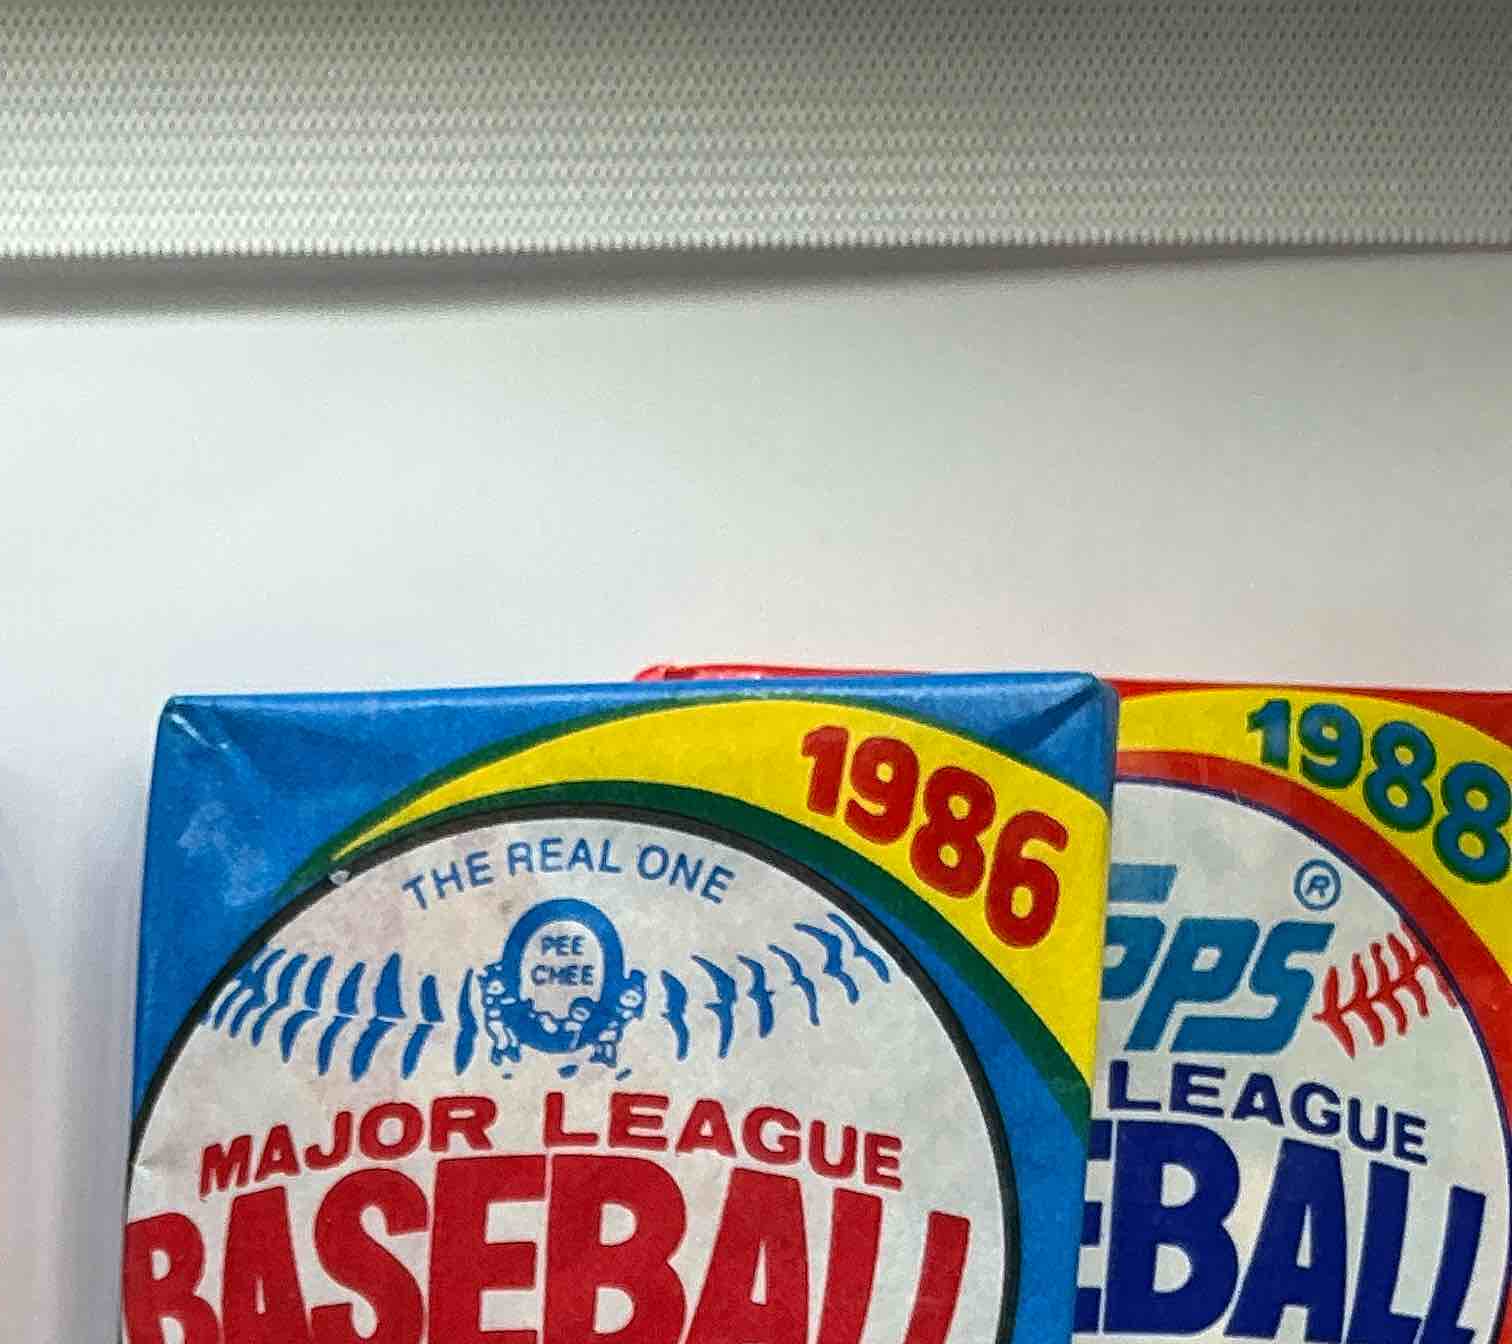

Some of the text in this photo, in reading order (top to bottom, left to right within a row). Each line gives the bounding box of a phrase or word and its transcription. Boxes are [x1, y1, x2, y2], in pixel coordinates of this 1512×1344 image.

[800, 724, 1071, 949] 1986
[1247, 699, 1511, 883] 1988
[402, 836, 736, 913] THE REAL ONE
[531, 965, 594, 985] CHEE
[541, 936, 584, 956] PEE
[197, 1093, 904, 1195] MAJOR LEAGUE
[1109, 1061, 1427, 1166] LEAGUE
